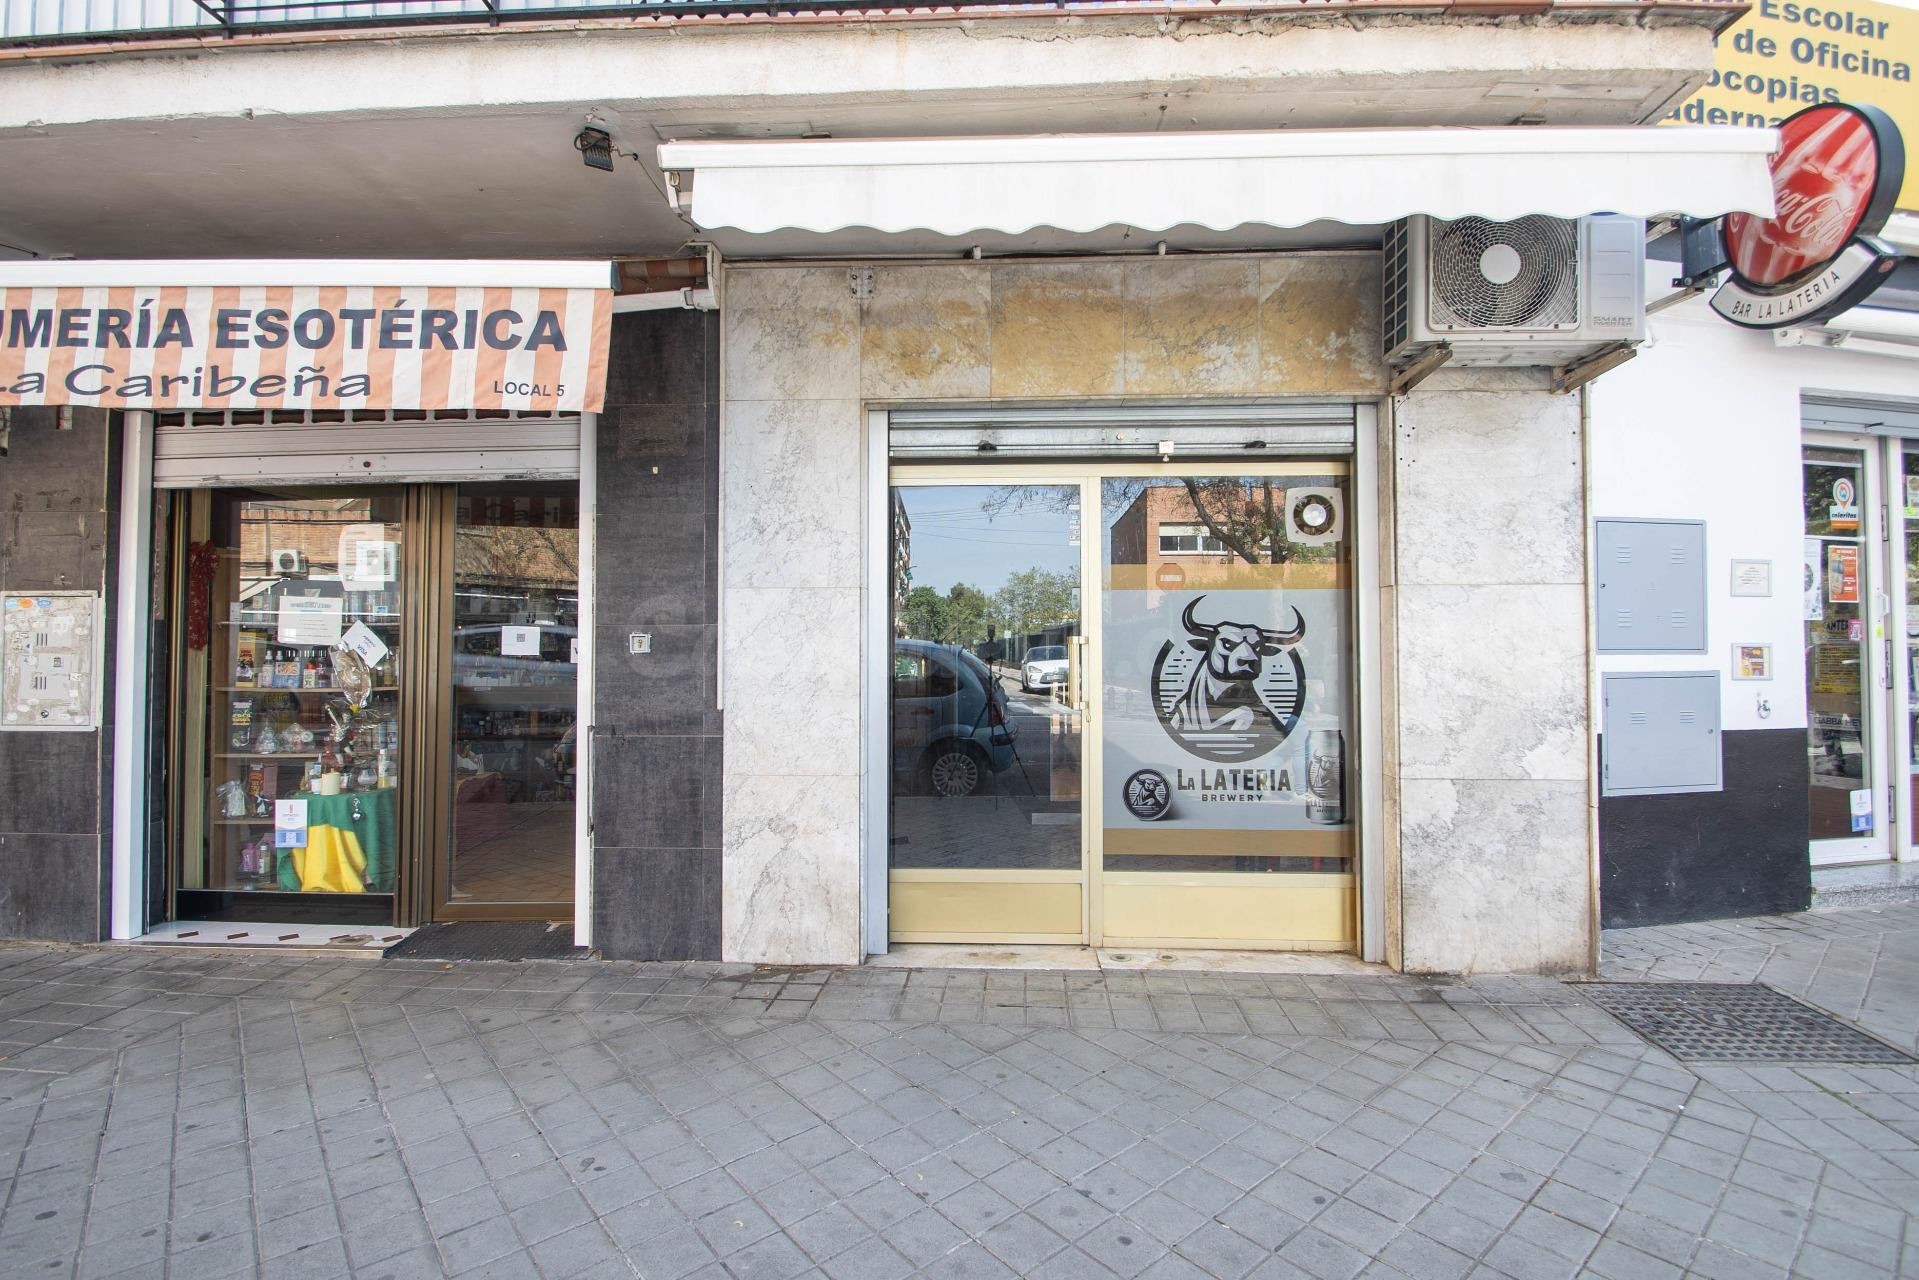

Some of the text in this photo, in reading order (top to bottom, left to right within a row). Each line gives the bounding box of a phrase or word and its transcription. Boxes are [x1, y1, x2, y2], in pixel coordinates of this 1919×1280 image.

[1760, 0, 1890, 41] Escolar
[1733, 28, 1912, 83] de Oficina
[1731, 270, 1841, 319] BAR LA LATERIA
[0, 298, 568, 352] MERÍA ESOTÉRICA
[0, 364, 371, 398] a Caribeña
[494, 380, 565, 397] LOCAL 5
[1201, 768, 1292, 792] LATERIA
[1201, 793, 1264, 802] BREWERY
